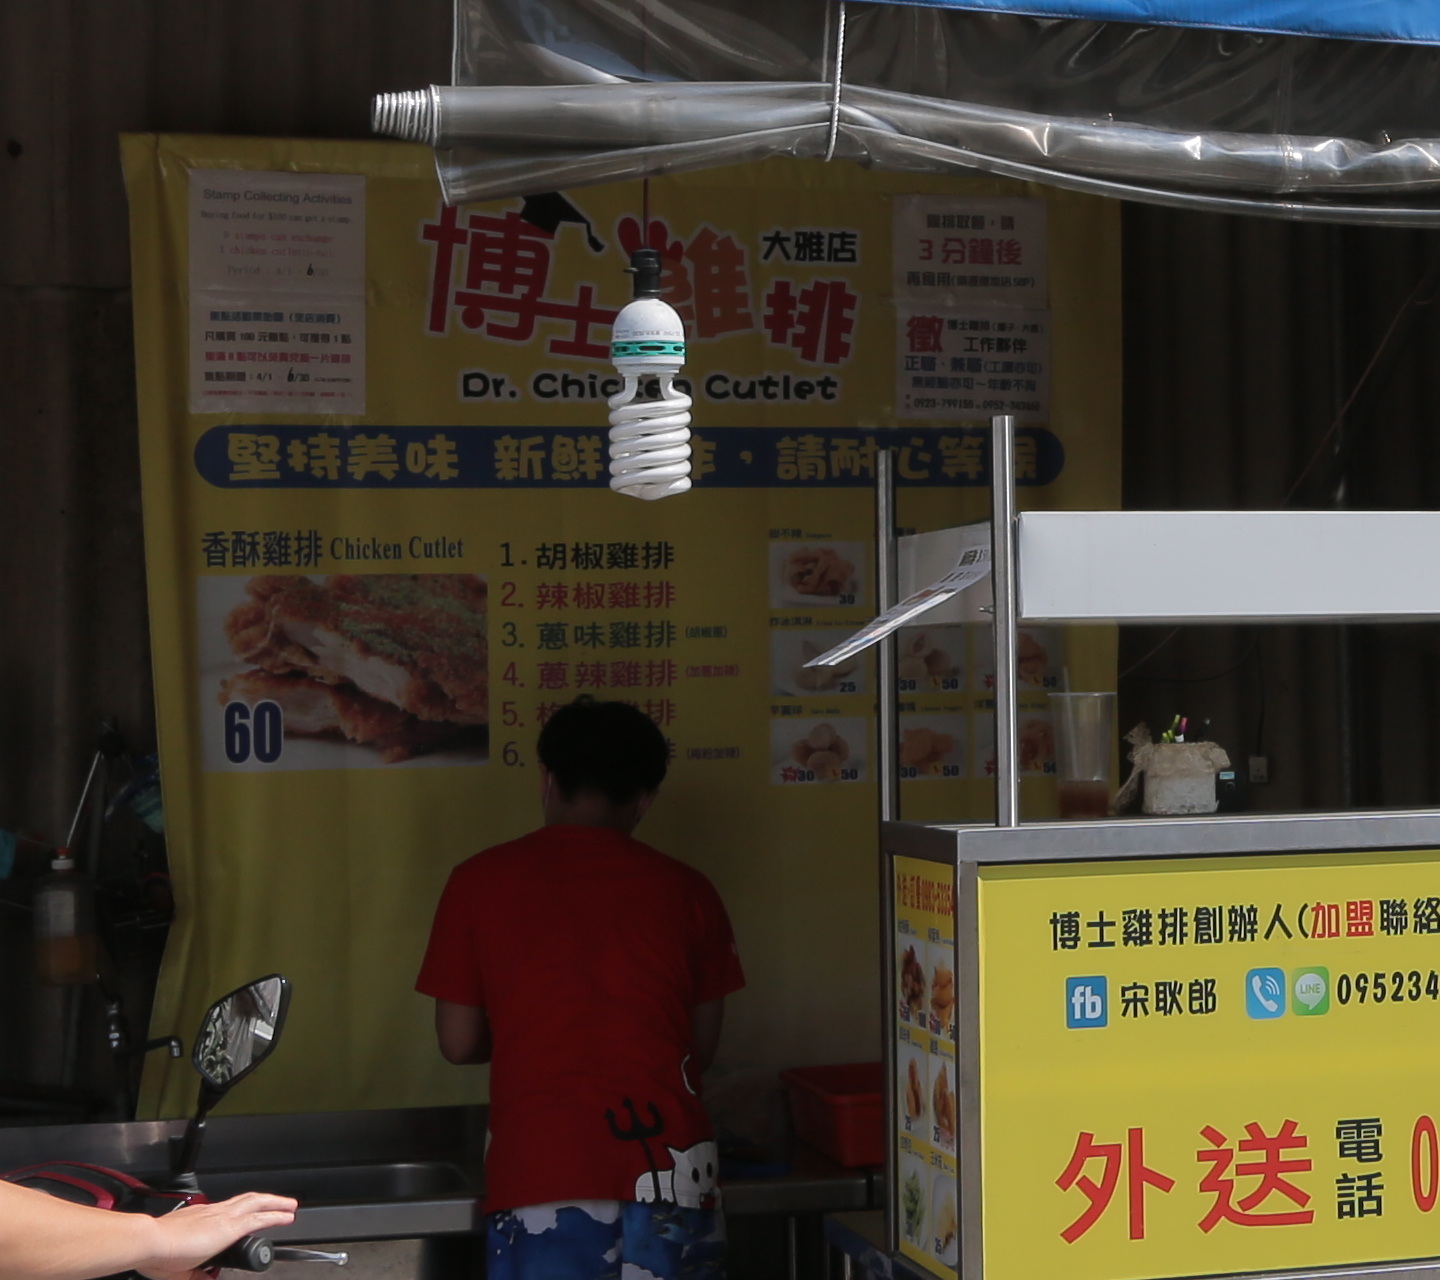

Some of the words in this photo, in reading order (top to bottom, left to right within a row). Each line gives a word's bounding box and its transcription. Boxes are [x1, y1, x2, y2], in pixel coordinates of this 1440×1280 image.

[203, 189, 241, 202] Stamp
[244, 190, 300, 204] Collecting
[302, 193, 353, 205] Activities
[762, 229, 858, 264] 大雅店
[462, 373, 517, 399] Dr.
[704, 374, 838, 401] Cutlet
[226, 433, 460, 481] 堅持美味
[201, 529, 324, 568] 香酥雞排
[329, 536, 402, 562] Chicken
[408, 535, 465, 560] Cutlet
[535, 541, 675, 571] 胡椒雞排
[535, 581, 677, 611] 辣椒雞排
[839, 594, 855, 605] 30
[839, 682, 856, 693] 25
[899, 679, 916, 691] 30
[941, 678, 959, 690] 50
[223, 700, 284, 764] 60
[797, 770, 814, 782] 30
[841, 768, 858, 780] 50
[943, 765, 960, 776] 50
[1299, 983, 1322, 995] LINE
[1054, 1118, 1317, 1247] 外送
[1335, 1117, 1384, 1220] 電話
